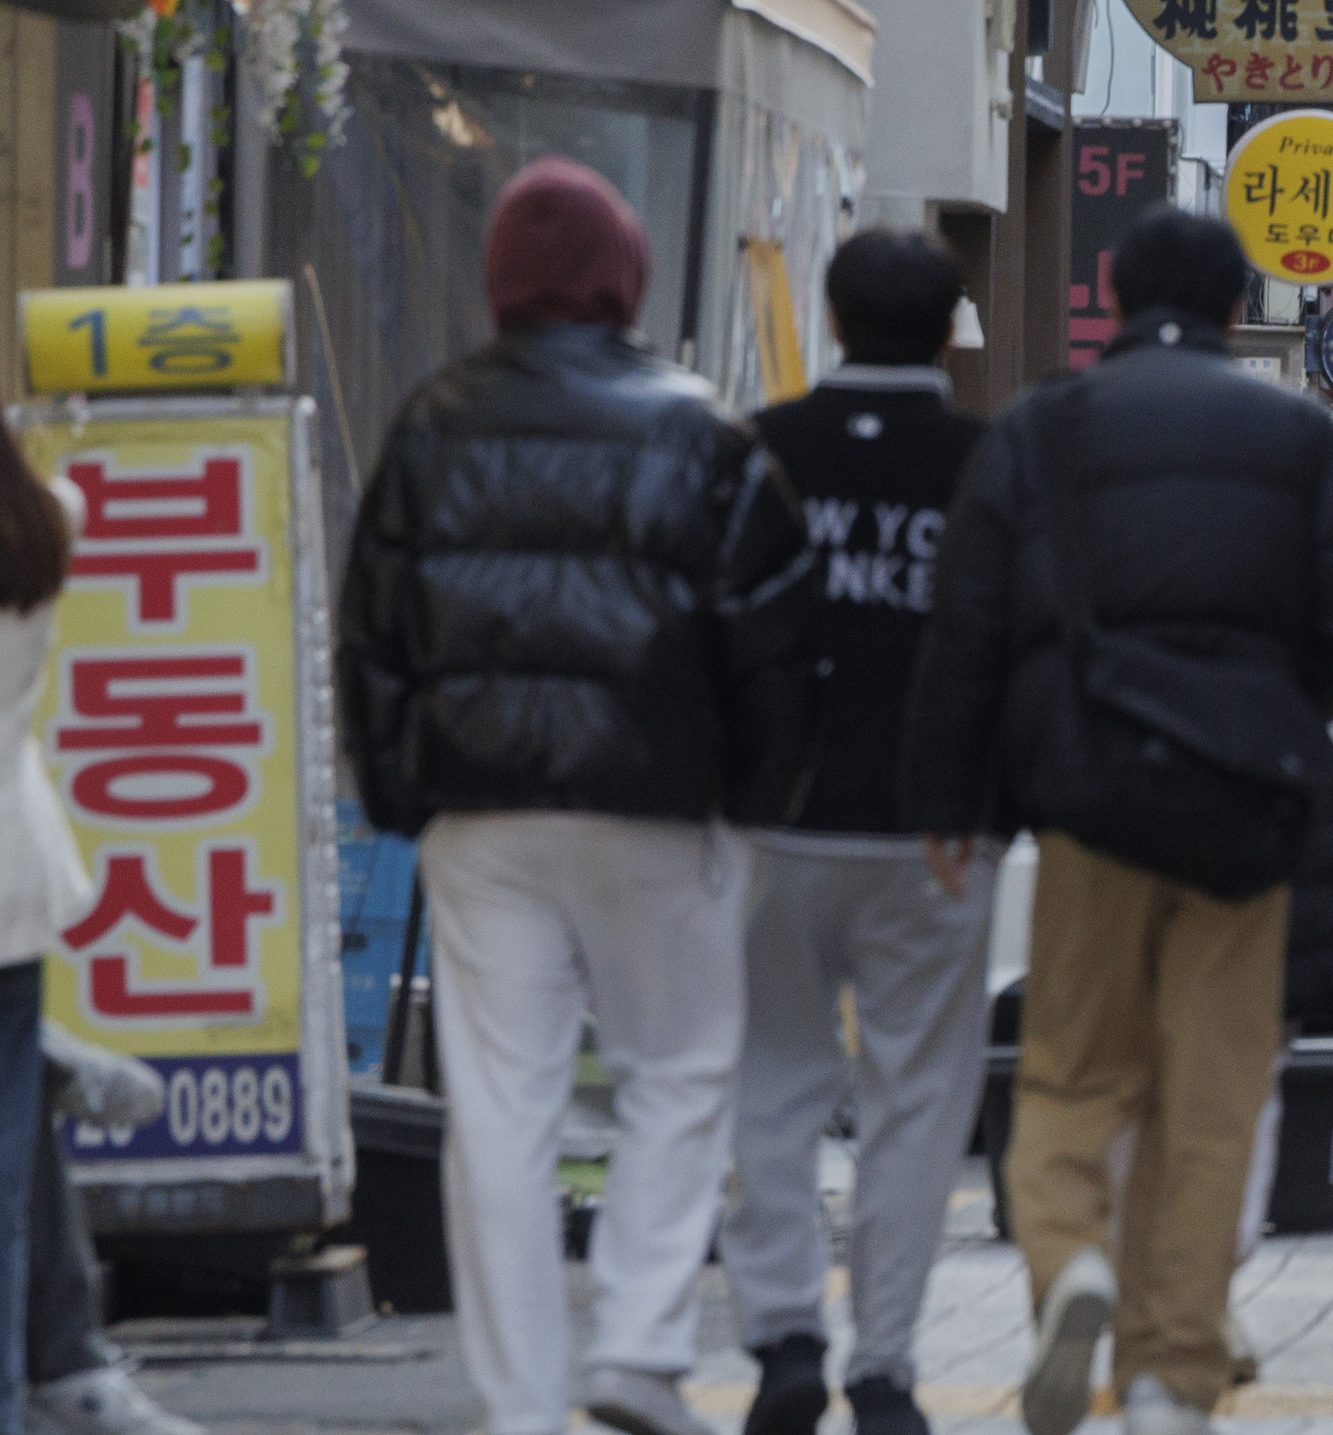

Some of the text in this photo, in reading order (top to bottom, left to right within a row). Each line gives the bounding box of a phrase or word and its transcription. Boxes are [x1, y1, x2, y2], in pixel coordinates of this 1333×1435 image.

[1078, 145, 1146, 196] 5F
[67, 306, 241, 378] 1층
[57, 456, 275, 1018] 부동산
